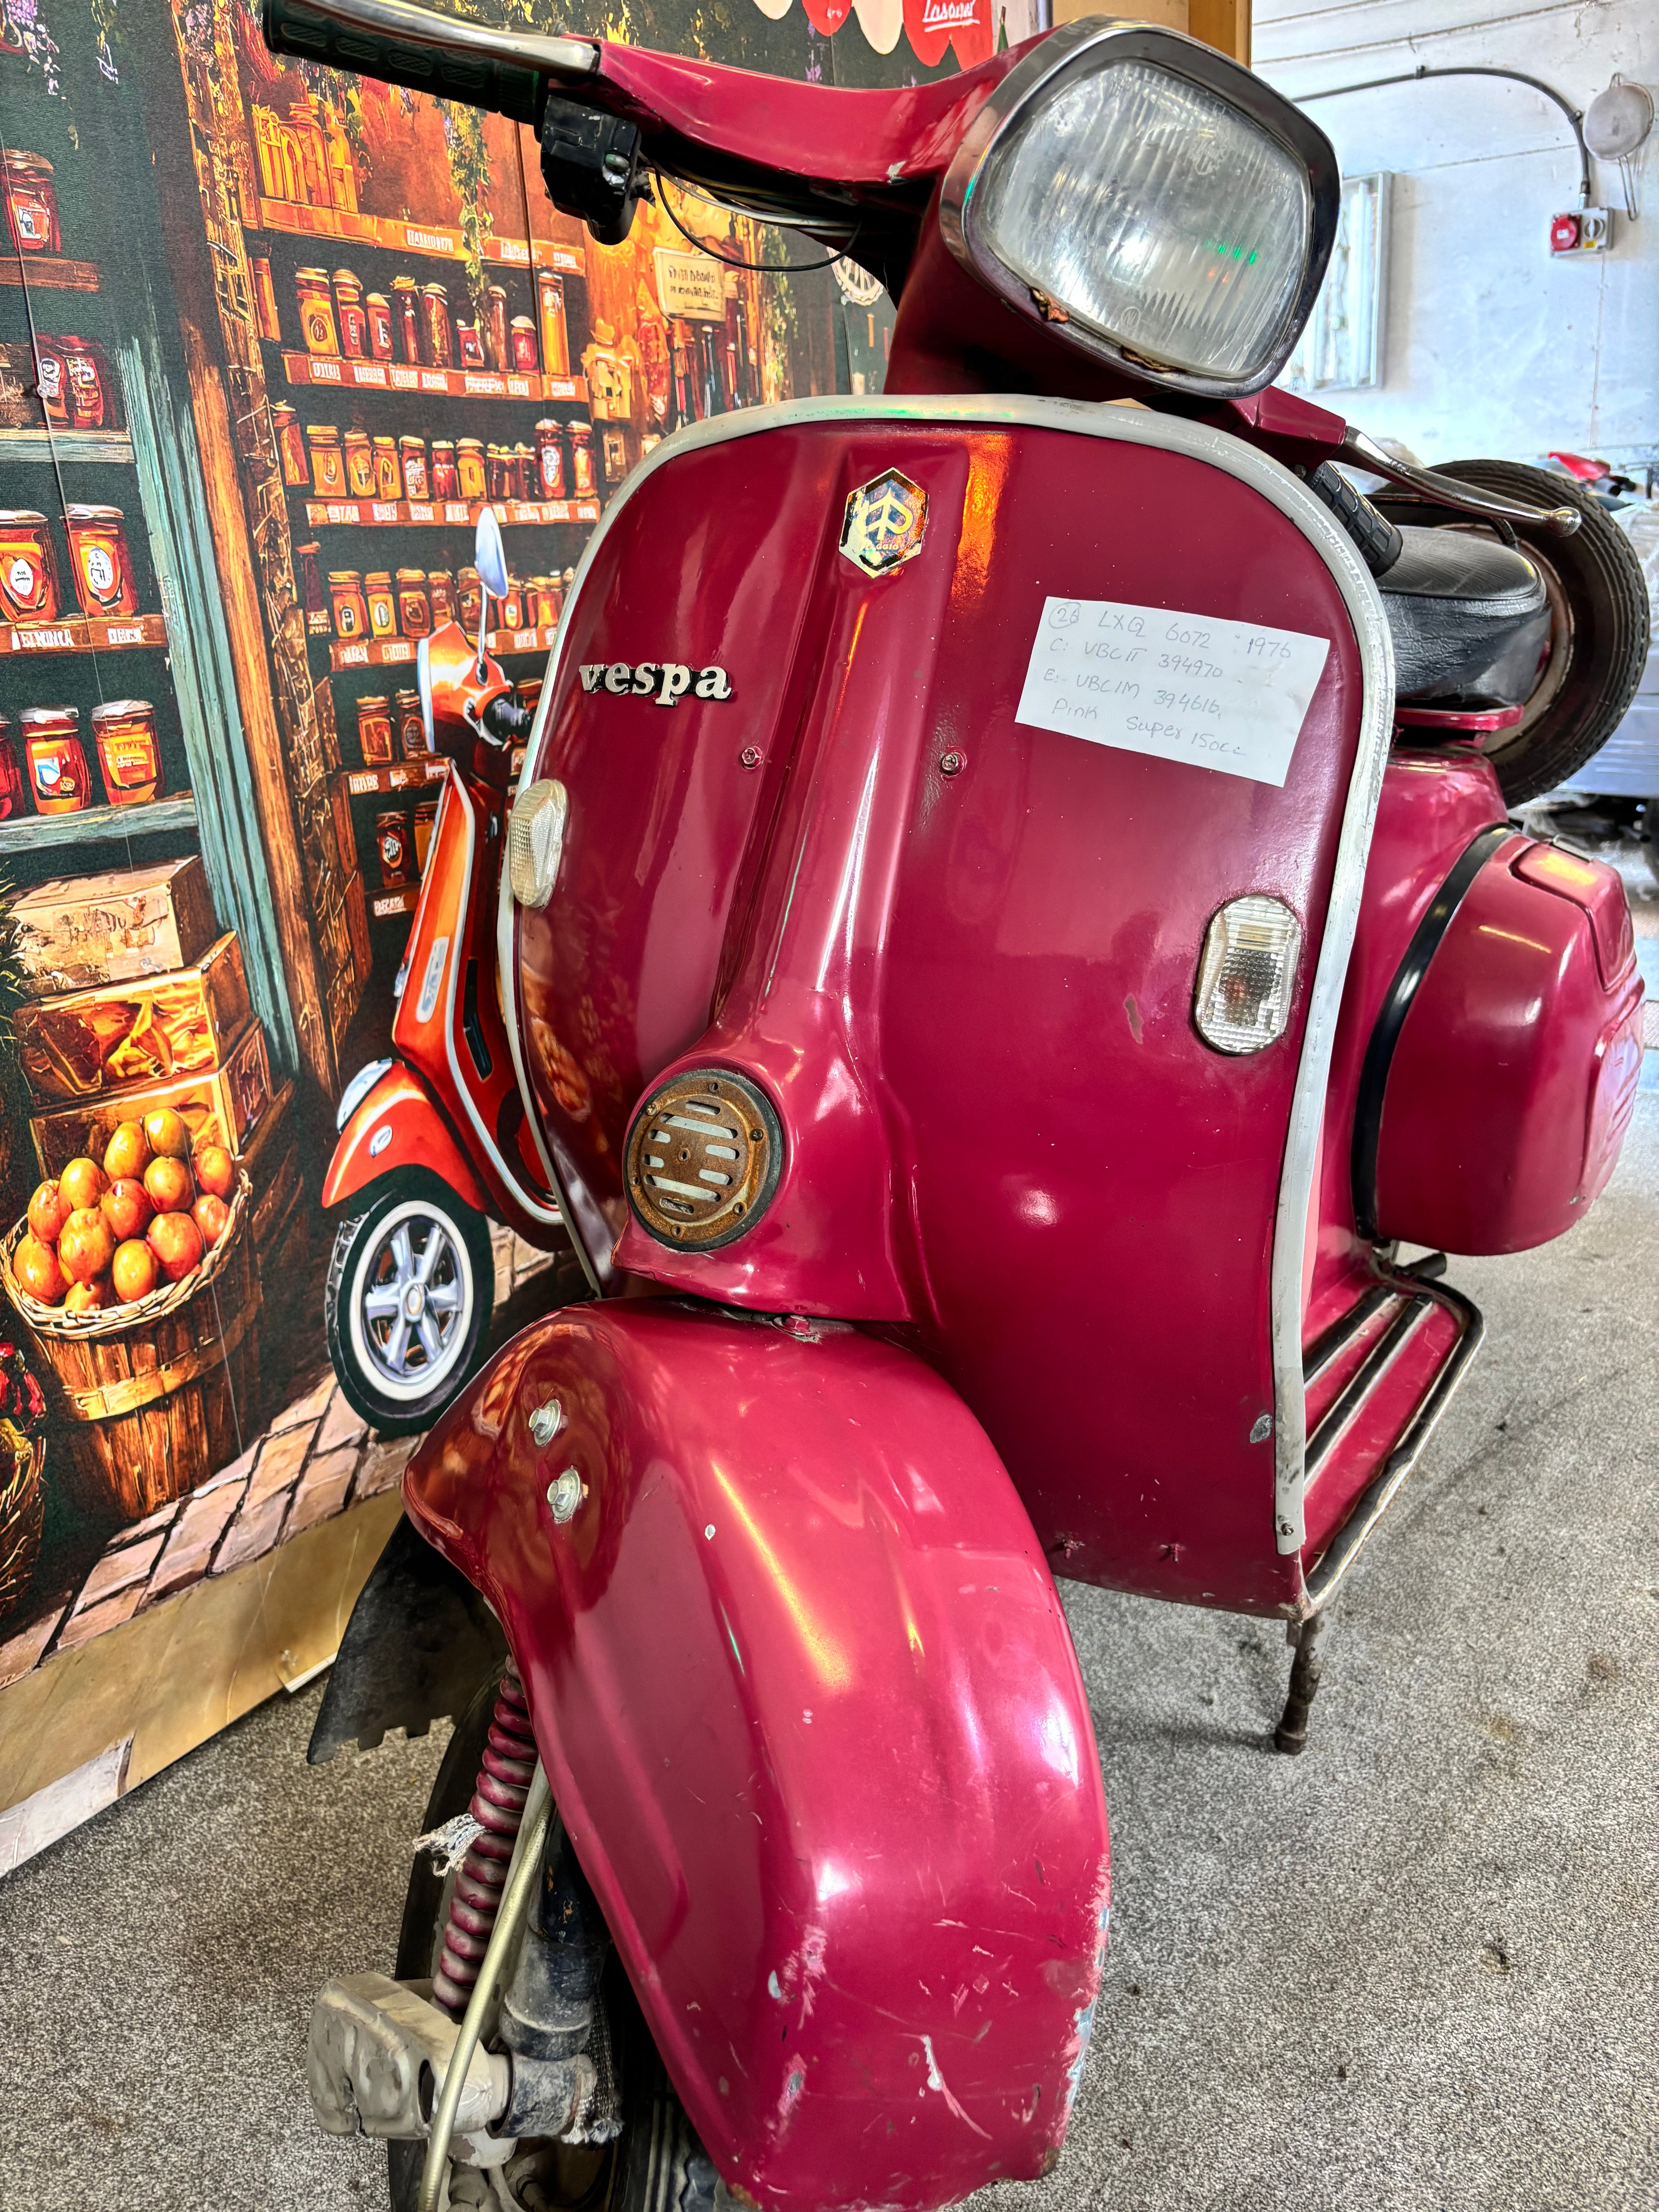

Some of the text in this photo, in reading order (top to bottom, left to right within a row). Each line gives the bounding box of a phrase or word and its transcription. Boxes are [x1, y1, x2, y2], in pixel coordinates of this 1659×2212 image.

[1098, 610, 1145, 637] LXQ
[1166, 623, 1210, 649] 6072
[1247, 637, 1291, 658] 1976
[578, 662, 732, 706] vespa
[1158, 654, 1222, 677] 394970
[1052, 698, 1097, 719] Pink
[1126, 716, 1183, 740] Super
